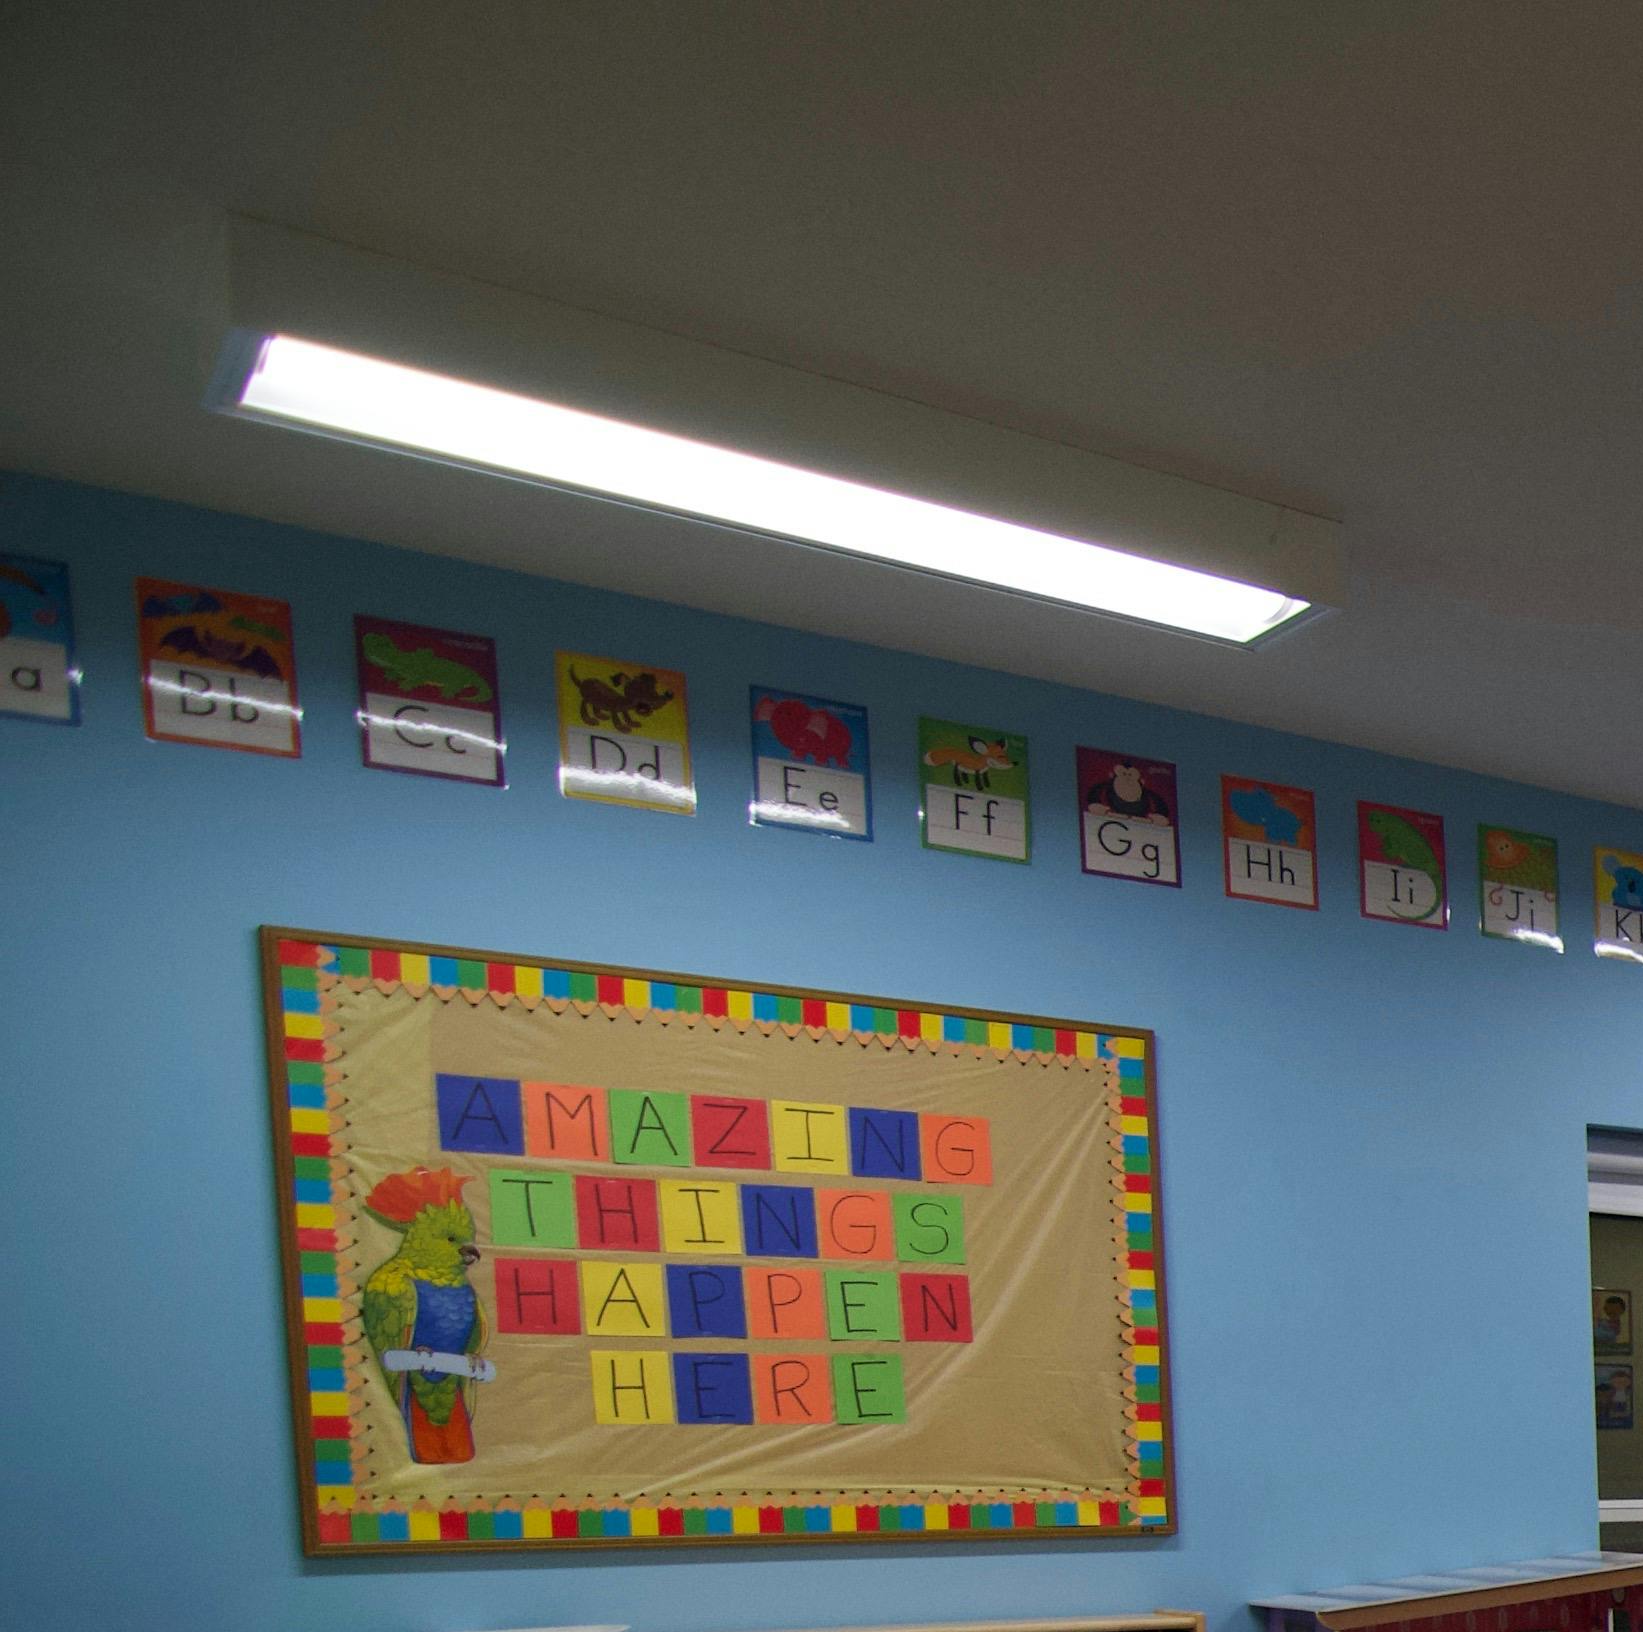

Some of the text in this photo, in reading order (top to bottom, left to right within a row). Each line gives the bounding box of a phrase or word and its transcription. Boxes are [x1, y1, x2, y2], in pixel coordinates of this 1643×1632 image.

[179, 668, 260, 724] Bb
[393, 704, 468, 755] Cc
[590, 734, 661, 781] Dd
[783, 765, 840, 812] Ee
[953, 792, 1000, 837] Ff
[1097, 820, 1161, 879] Gg
[1246, 843, 1296, 886] Hh
[1391, 868, 1415, 905] Ii
[452, 1081, 976, 1177] AMAZING
[502, 1178, 950, 1255] THINGS
[514, 1267, 958, 1333] HAPPEN
[611, 1358, 894, 1419] HERE
